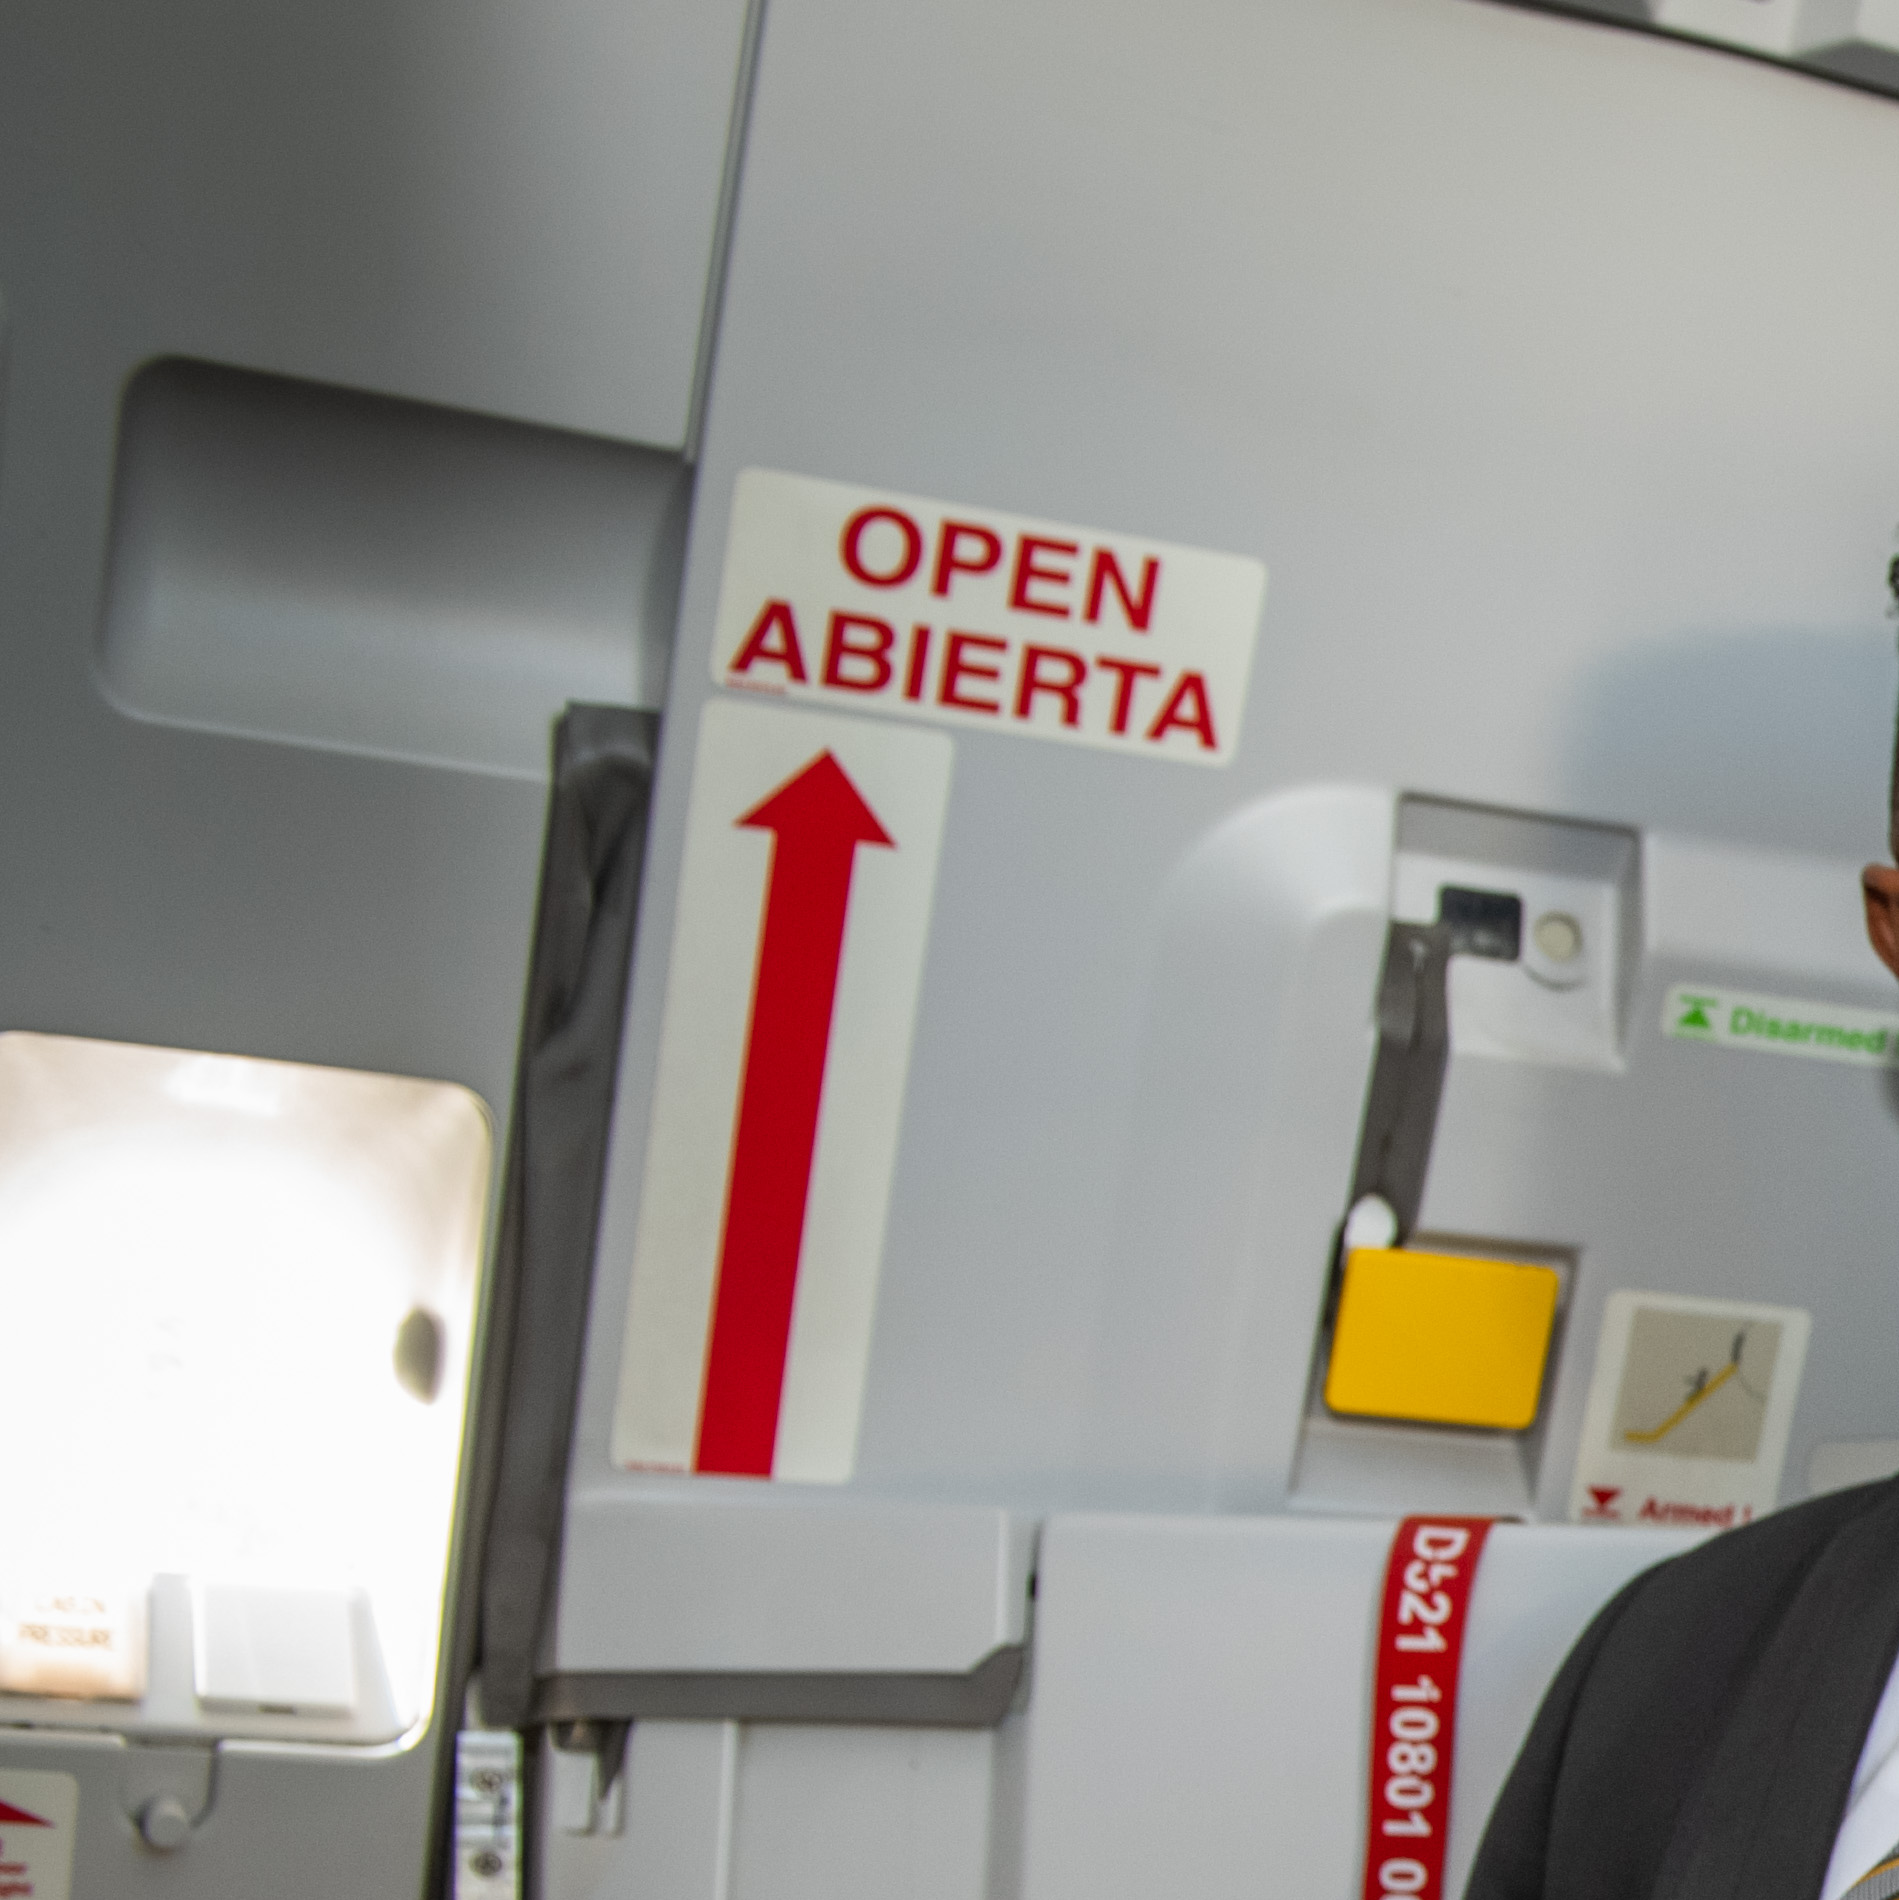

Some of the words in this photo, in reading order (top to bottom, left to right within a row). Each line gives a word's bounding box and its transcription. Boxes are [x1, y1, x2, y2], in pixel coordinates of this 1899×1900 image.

[838, 503, 1160, 634] OPEN
[727, 597, 1220, 752] ABIERTA
[1729, 1005, 1888, 1054] Disarmed
[1637, 1494, 1735, 1527] Armed
[1382, 1674, 1443, 1837] 10801
